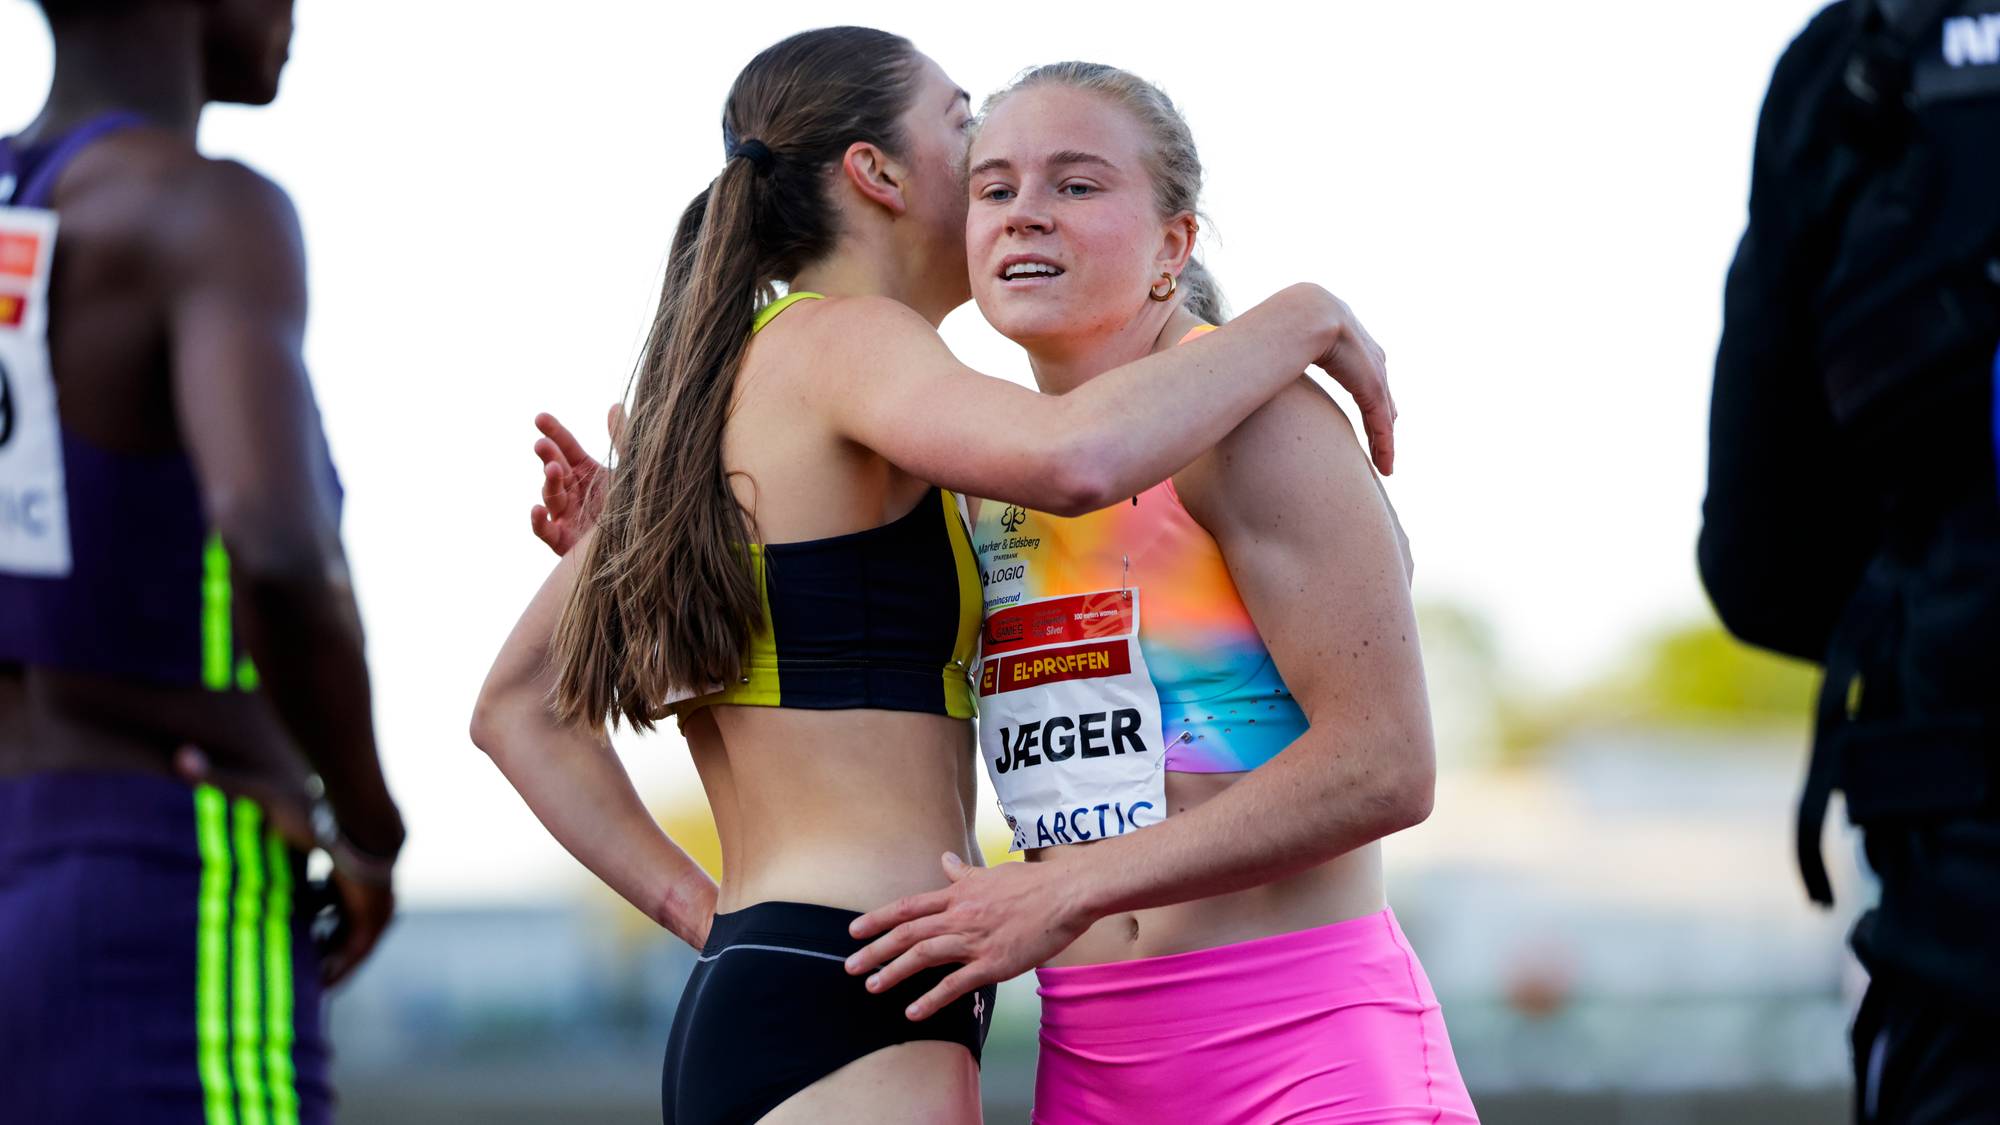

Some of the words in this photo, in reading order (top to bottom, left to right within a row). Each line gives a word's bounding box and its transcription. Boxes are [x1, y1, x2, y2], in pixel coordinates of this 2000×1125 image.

[978, 540, 1002, 555] Marker
[1002, 538, 1009, 550] &
[1009, 536, 1040, 550] Eidsberg
[1013, 651, 1109, 682] EL-PROFFEN
[995, 708, 1147, 774] JÆGER
[1036, 801, 1153, 847] ARCTIC
